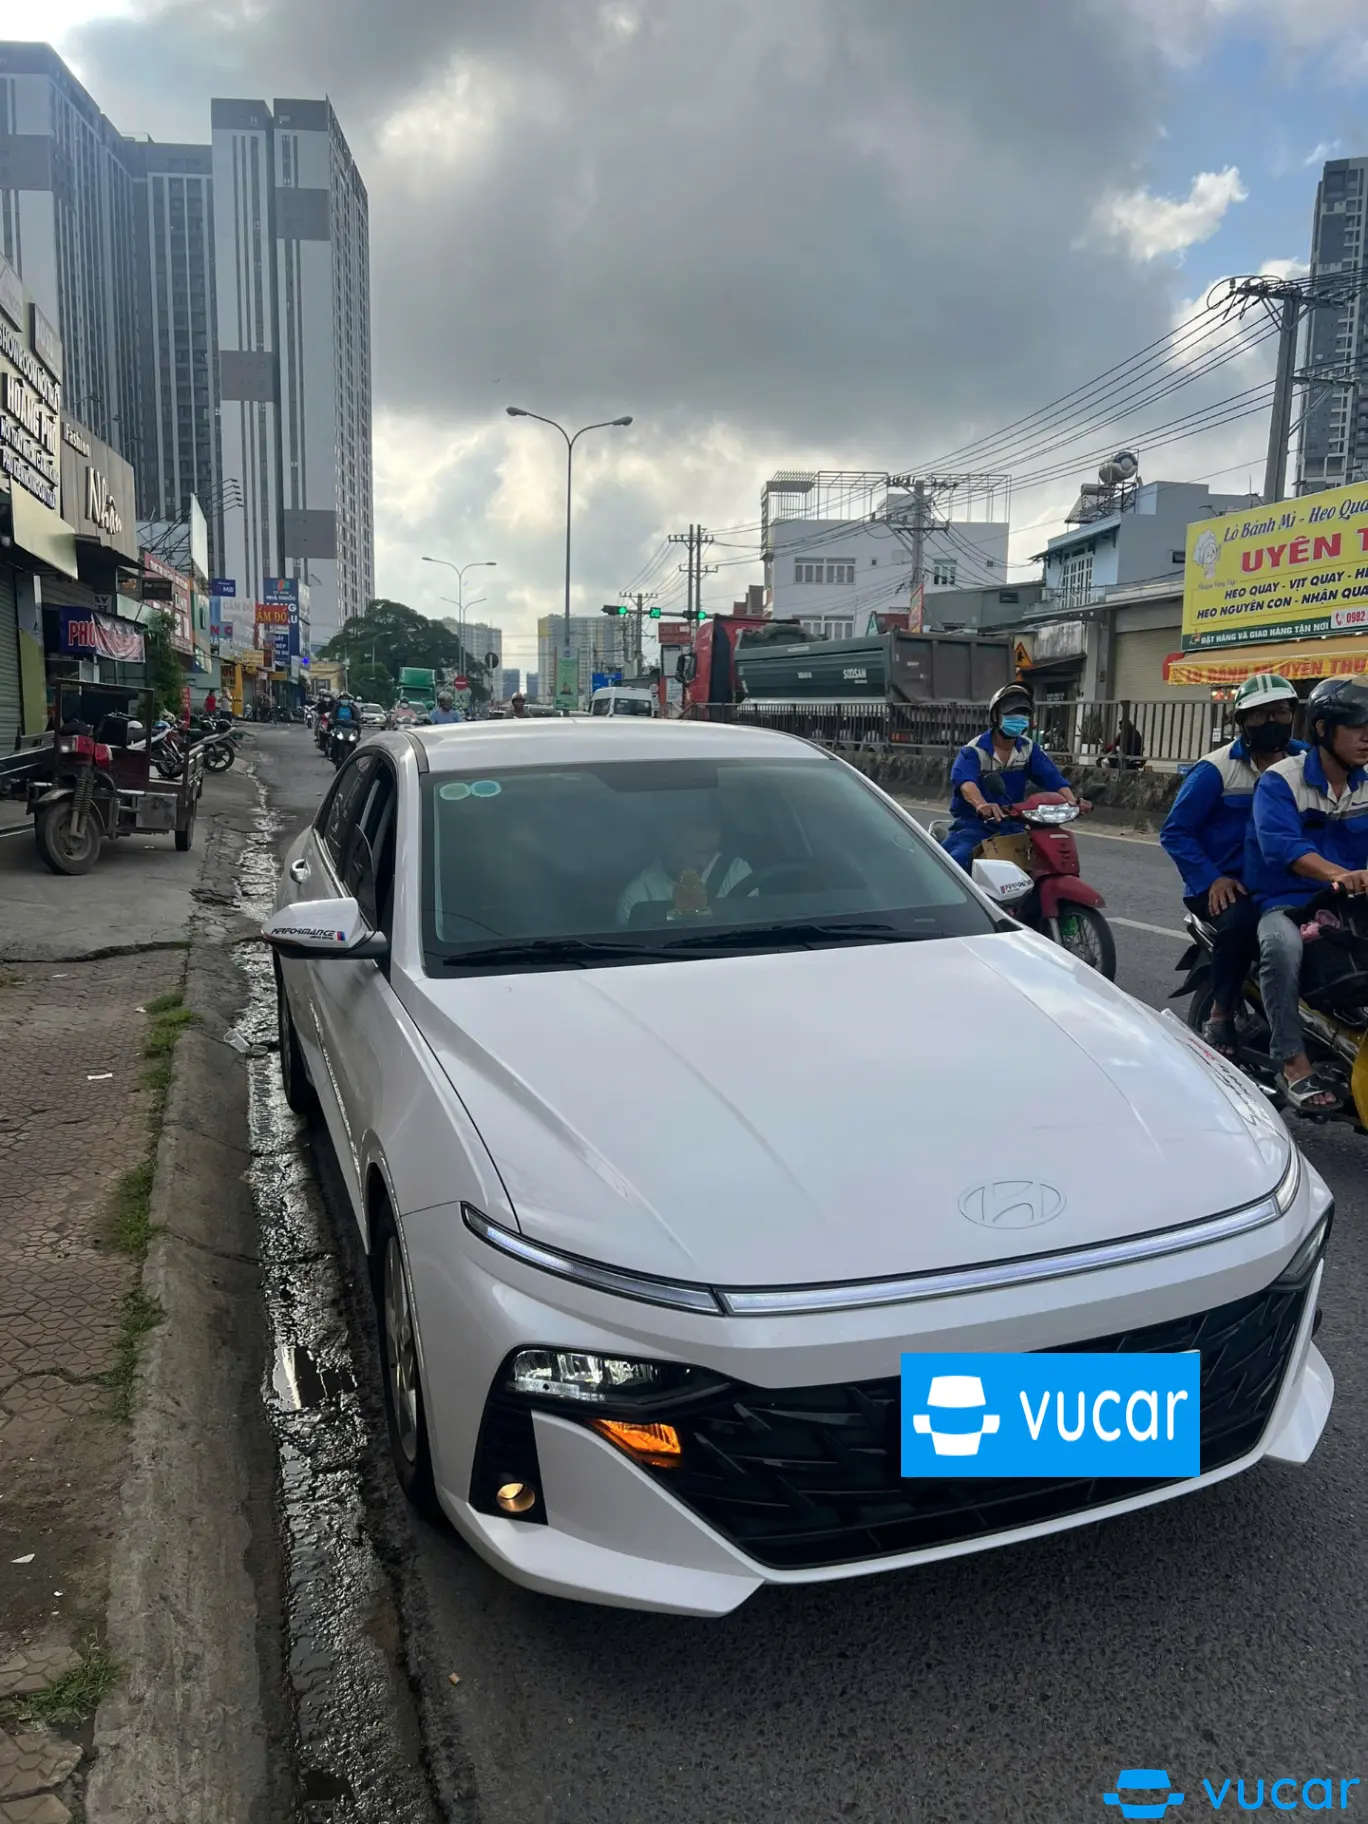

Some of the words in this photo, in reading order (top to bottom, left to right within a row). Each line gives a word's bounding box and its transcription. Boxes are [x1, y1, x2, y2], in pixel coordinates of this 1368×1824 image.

[1223, 524, 1239, 543] Lò
[1241, 516, 1276, 539] Bánh
[1308, 506, 1336, 524] Heo
[1241, 533, 1342, 573] UYÊN
[1224, 587, 1247, 601] HEO
[1249, 582, 1280, 596] QUAY
[1289, 577, 1307, 593] VỊT
[1310, 571, 1345, 587] QUAY
[1196, 608, 1218, 620] HEO
[1219, 600, 1264, 616] NGUYÊN
[1266, 597, 1293, 610] CON
[1301, 588, 1339, 605] NHẬN
[1346, 610, 1366, 624] 0982
[1216, 630, 1237, 644] HÀNG
[1238, 629, 1248, 640] VÀ
[1249, 627, 1268, 640] GIAO
[1269, 625, 1293, 638] HÀNG
[1294, 624, 1311, 635] TẬN
[270, 927, 336, 936] PERFORMANCE
